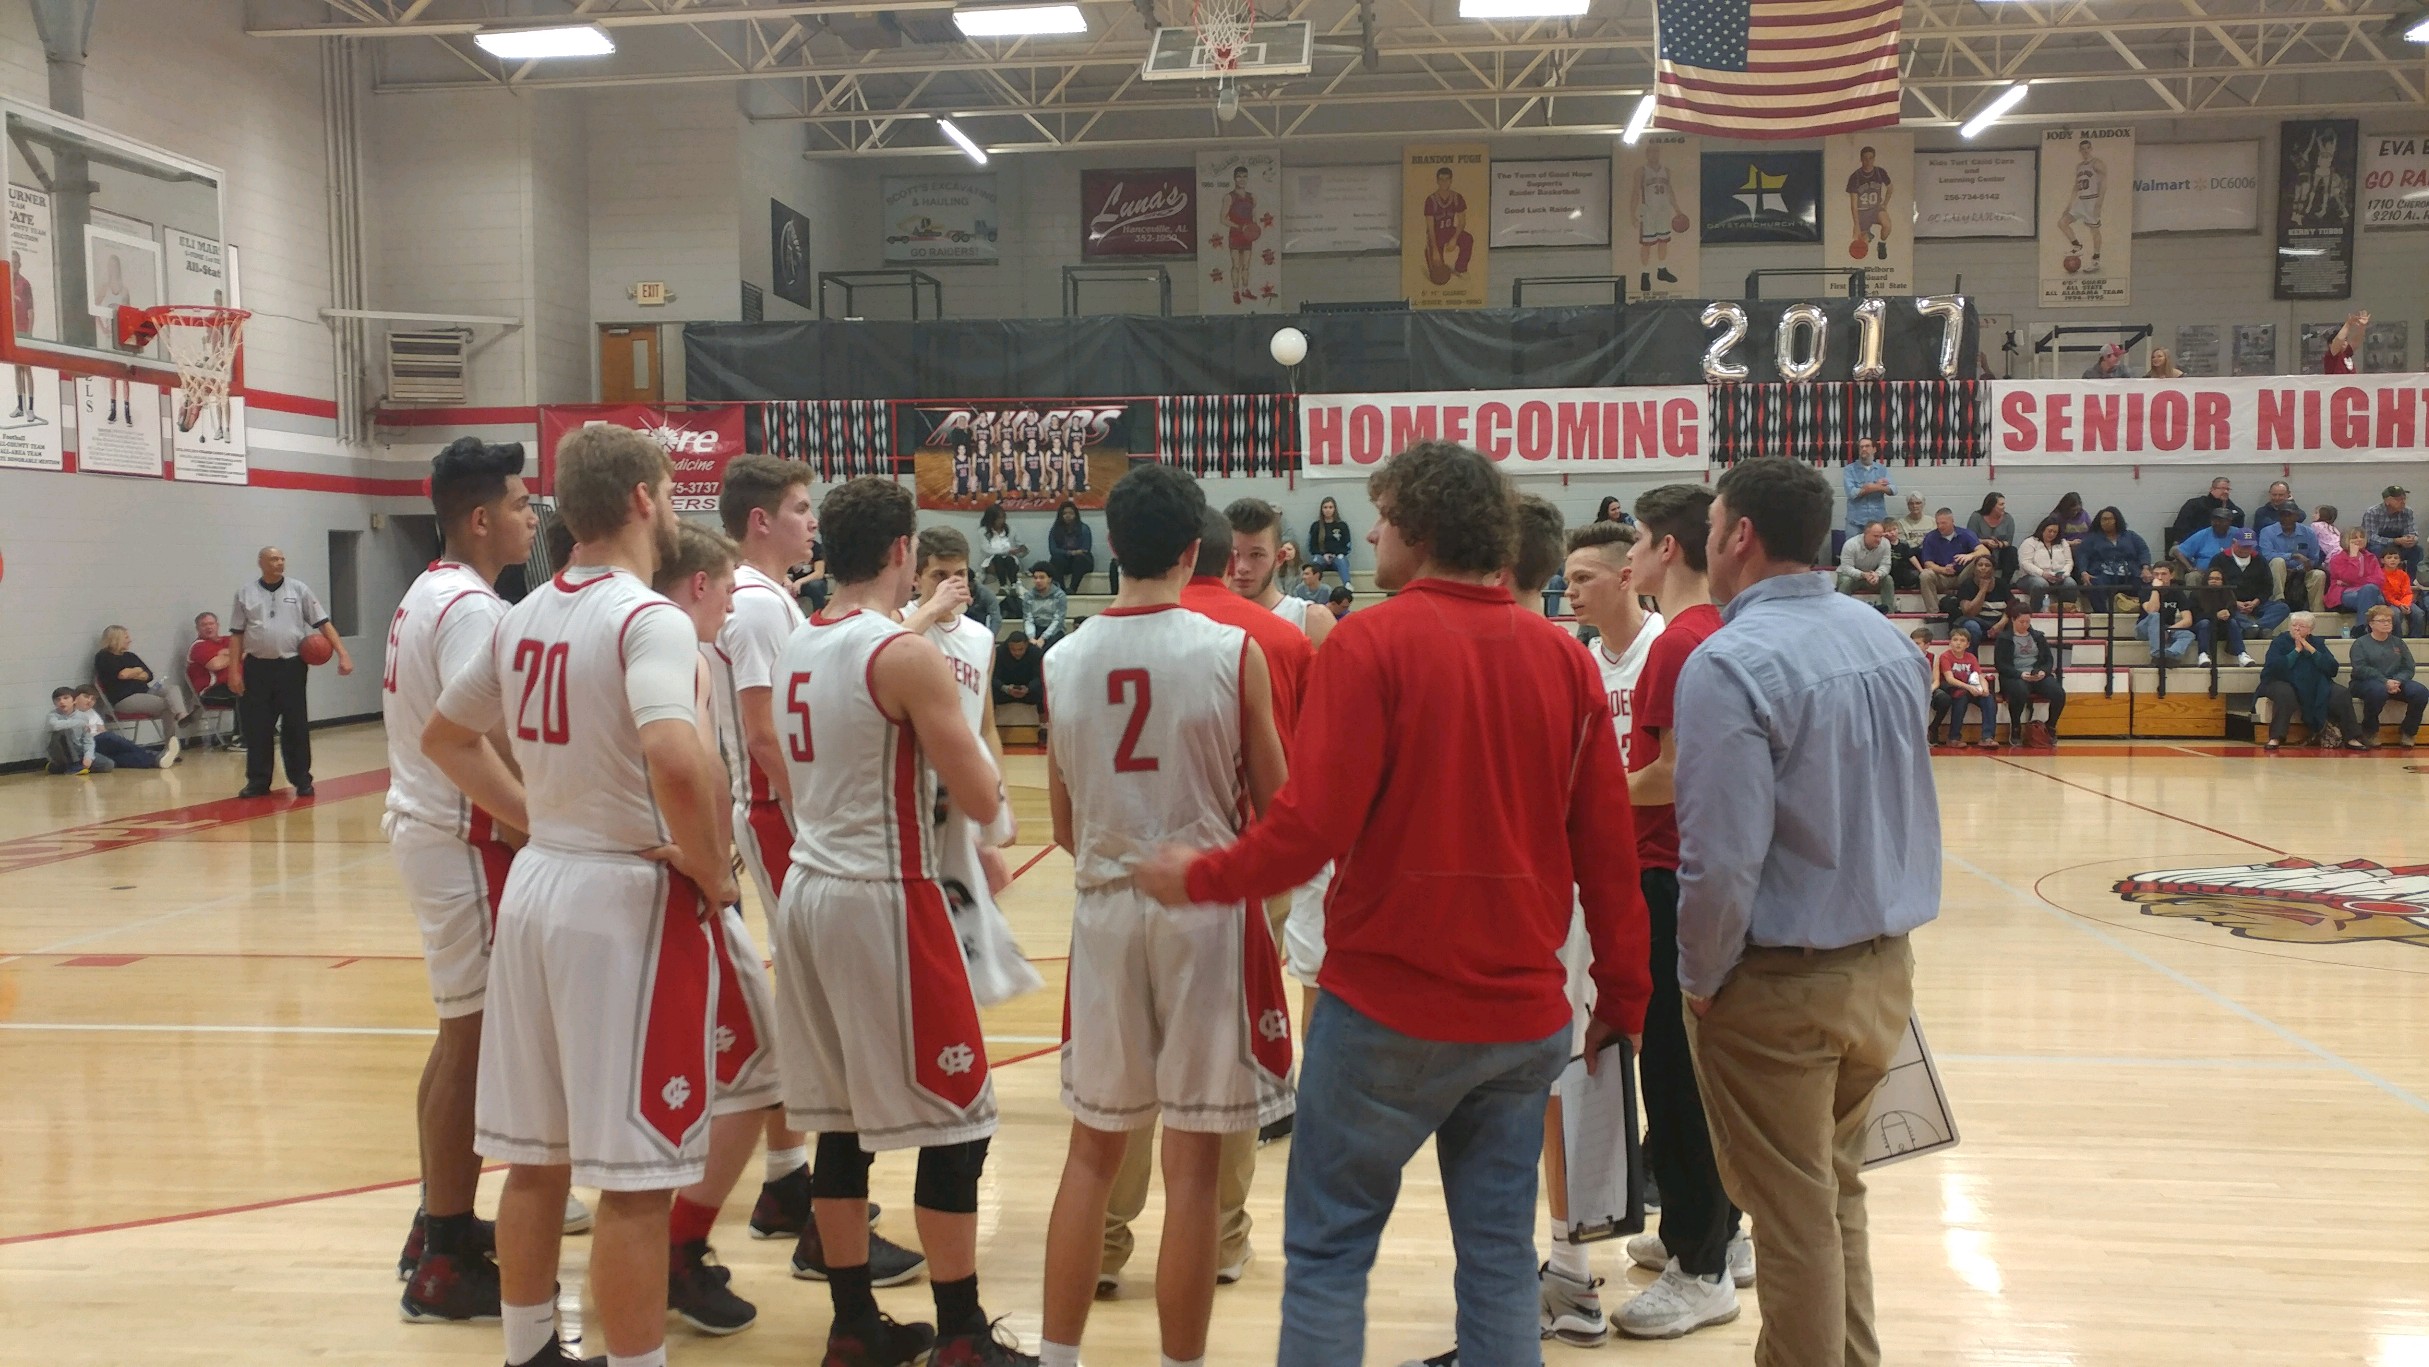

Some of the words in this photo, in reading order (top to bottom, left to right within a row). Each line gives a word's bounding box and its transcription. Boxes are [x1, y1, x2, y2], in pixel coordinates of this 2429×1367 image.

[2046, 131, 2073, 140] JODY
[2080, 129, 2131, 139] MADDOX
[2379, 140, 2415, 156] EVA
[1411, 155, 1453, 164] BRANDON
[1458, 154, 1482, 163] PUGH
[2211, 177, 2256, 190] DC6006
[2365, 171, 2394, 189] GO
[8, 188, 47, 207] URNER
[922, 198, 969, 206] HAULING
[2368, 199, 2394, 210] 1710
[180, 236, 195, 249] ELI
[911, 248, 926, 256] GO
[186, 260, 221, 278] All-Stat
[642, 284, 659, 298] EXIT
[2001, 390, 2233, 452] SENIOR
[2256, 386, 2429, 450] NIGH
[1308, 397, 1700, 465] HOMECOMING
[671, 498, 717, 511] ERS
[945, 655, 981, 696] ERS
[512, 637, 571, 746] 20
[787, 671, 815, 763] 5
[1107, 667, 1160, 774] 2
